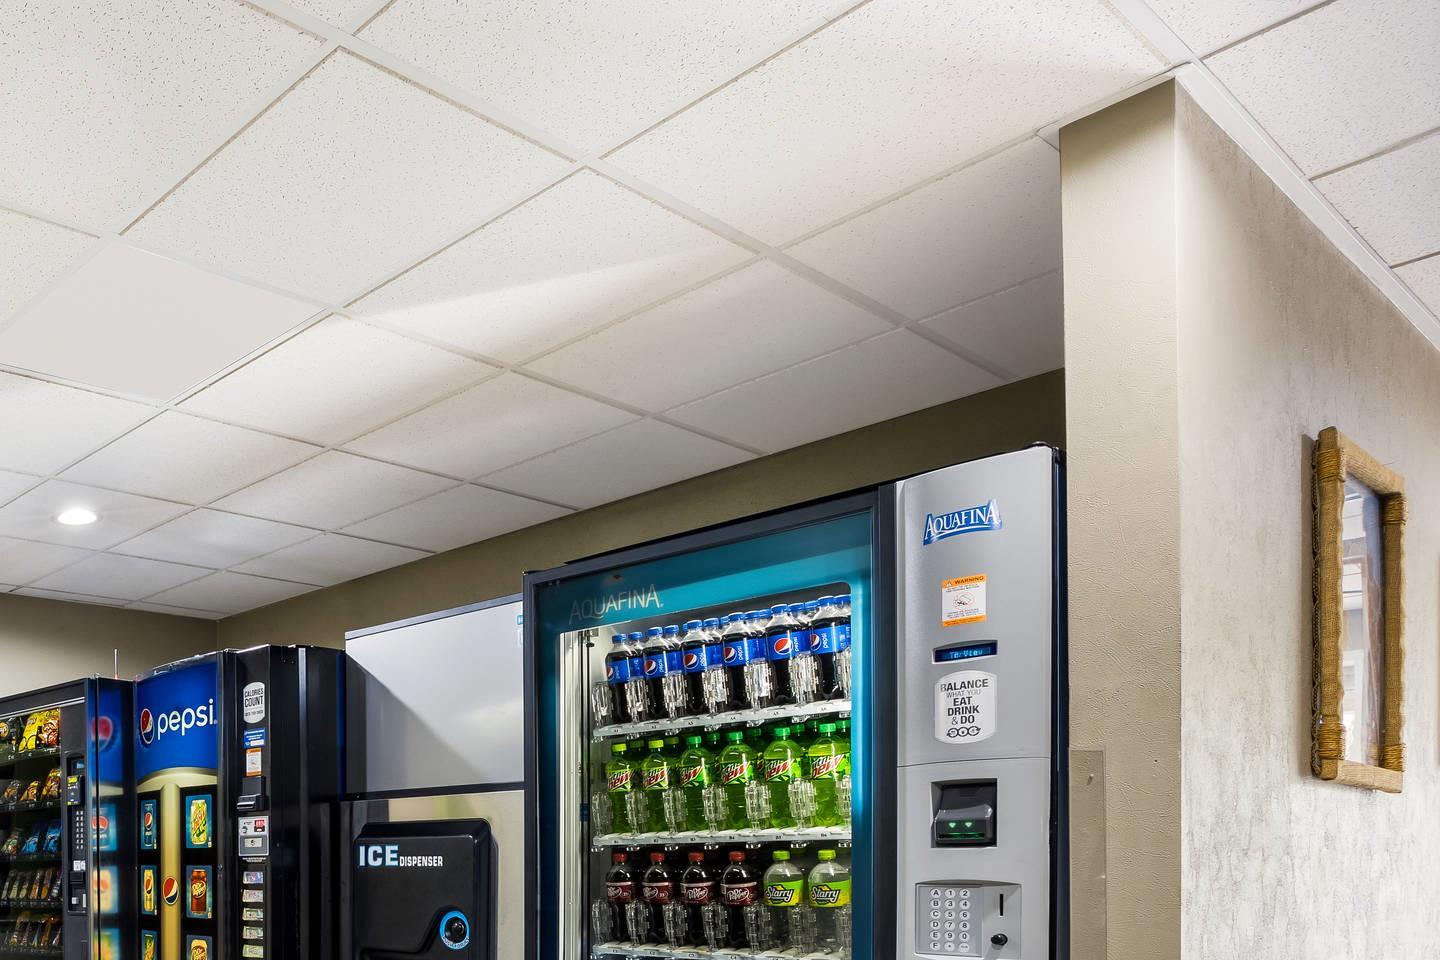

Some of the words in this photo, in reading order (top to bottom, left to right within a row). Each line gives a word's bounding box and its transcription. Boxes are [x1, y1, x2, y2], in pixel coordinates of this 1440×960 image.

[924, 499, 1001, 540] AQUAFINA
[955, 576, 984, 584] WARNING
[569, 583, 660, 625] AQUAFINA
[940, 679, 989, 692] BALANCE
[244, 688, 264, 697] CALORIES
[946, 690, 965, 699] WHAT
[244, 696, 264, 708] COUNT
[953, 696, 972, 706] EAT
[947, 705, 980, 716] DRINK
[157, 698, 214, 740] pepsi
[951, 716, 958, 725] &
[960, 714, 975, 724] DO
[359, 845, 399, 867] ICE
[399, 855, 443, 867] DISPENSER
[766, 885, 793, 902] Starry
[812, 885, 840, 903] Starry
